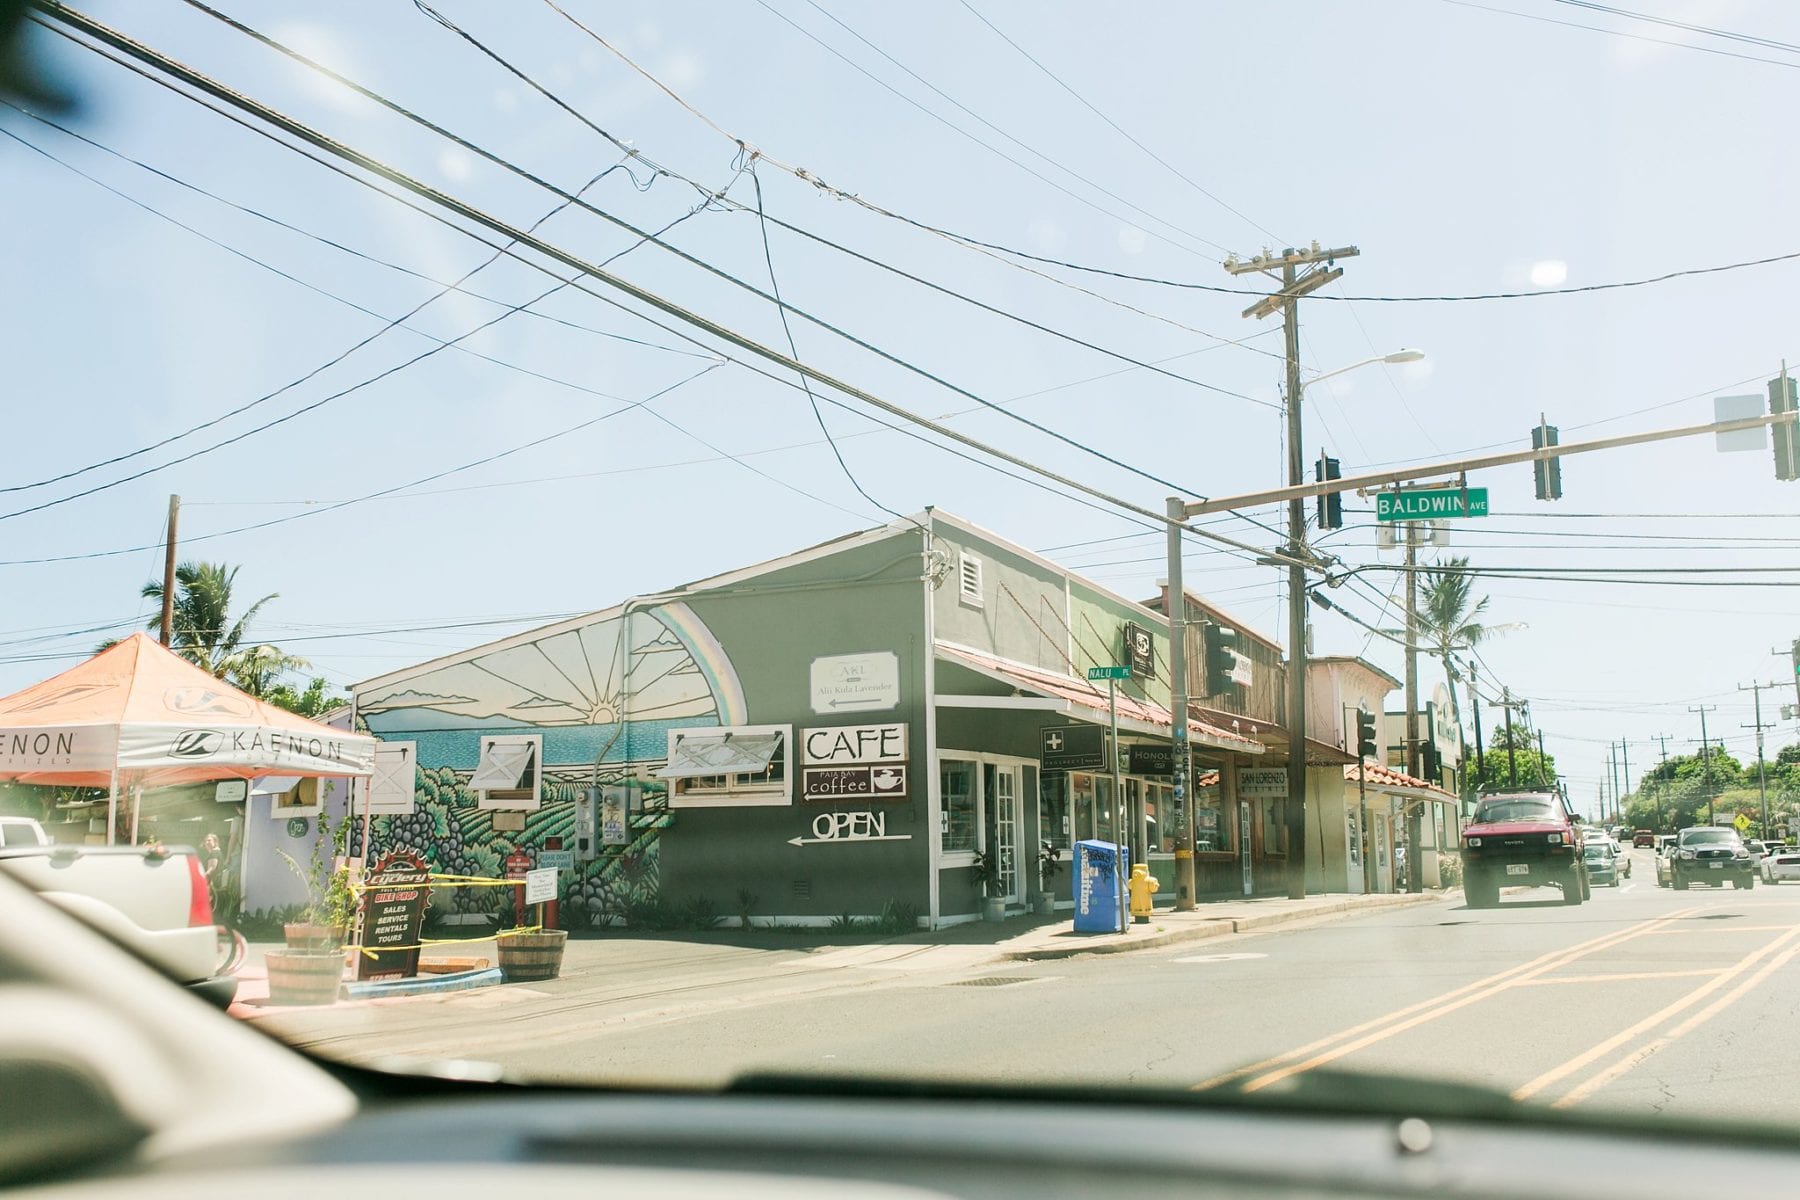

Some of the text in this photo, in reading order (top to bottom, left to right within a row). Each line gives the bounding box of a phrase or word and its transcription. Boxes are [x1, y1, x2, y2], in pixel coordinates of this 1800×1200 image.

[1379, 496, 1486, 515] BALDWIN AVE
[1089, 668, 1130, 679] NALU PL
[232, 731, 342, 760] KAENON
[807, 728, 901, 759] CAFE
[1241, 772, 1285, 784] SAN LORENZO
[810, 776, 868, 793] coffee
[812, 811, 885, 839] OPEN
[375, 891, 418, 903] BIKE SHOP
[383, 905, 407, 915] SALES
[377, 914, 409, 925] SERVICE
[375, 924, 408, 935] RENTALS
[378, 934, 403, 943] TOURS
